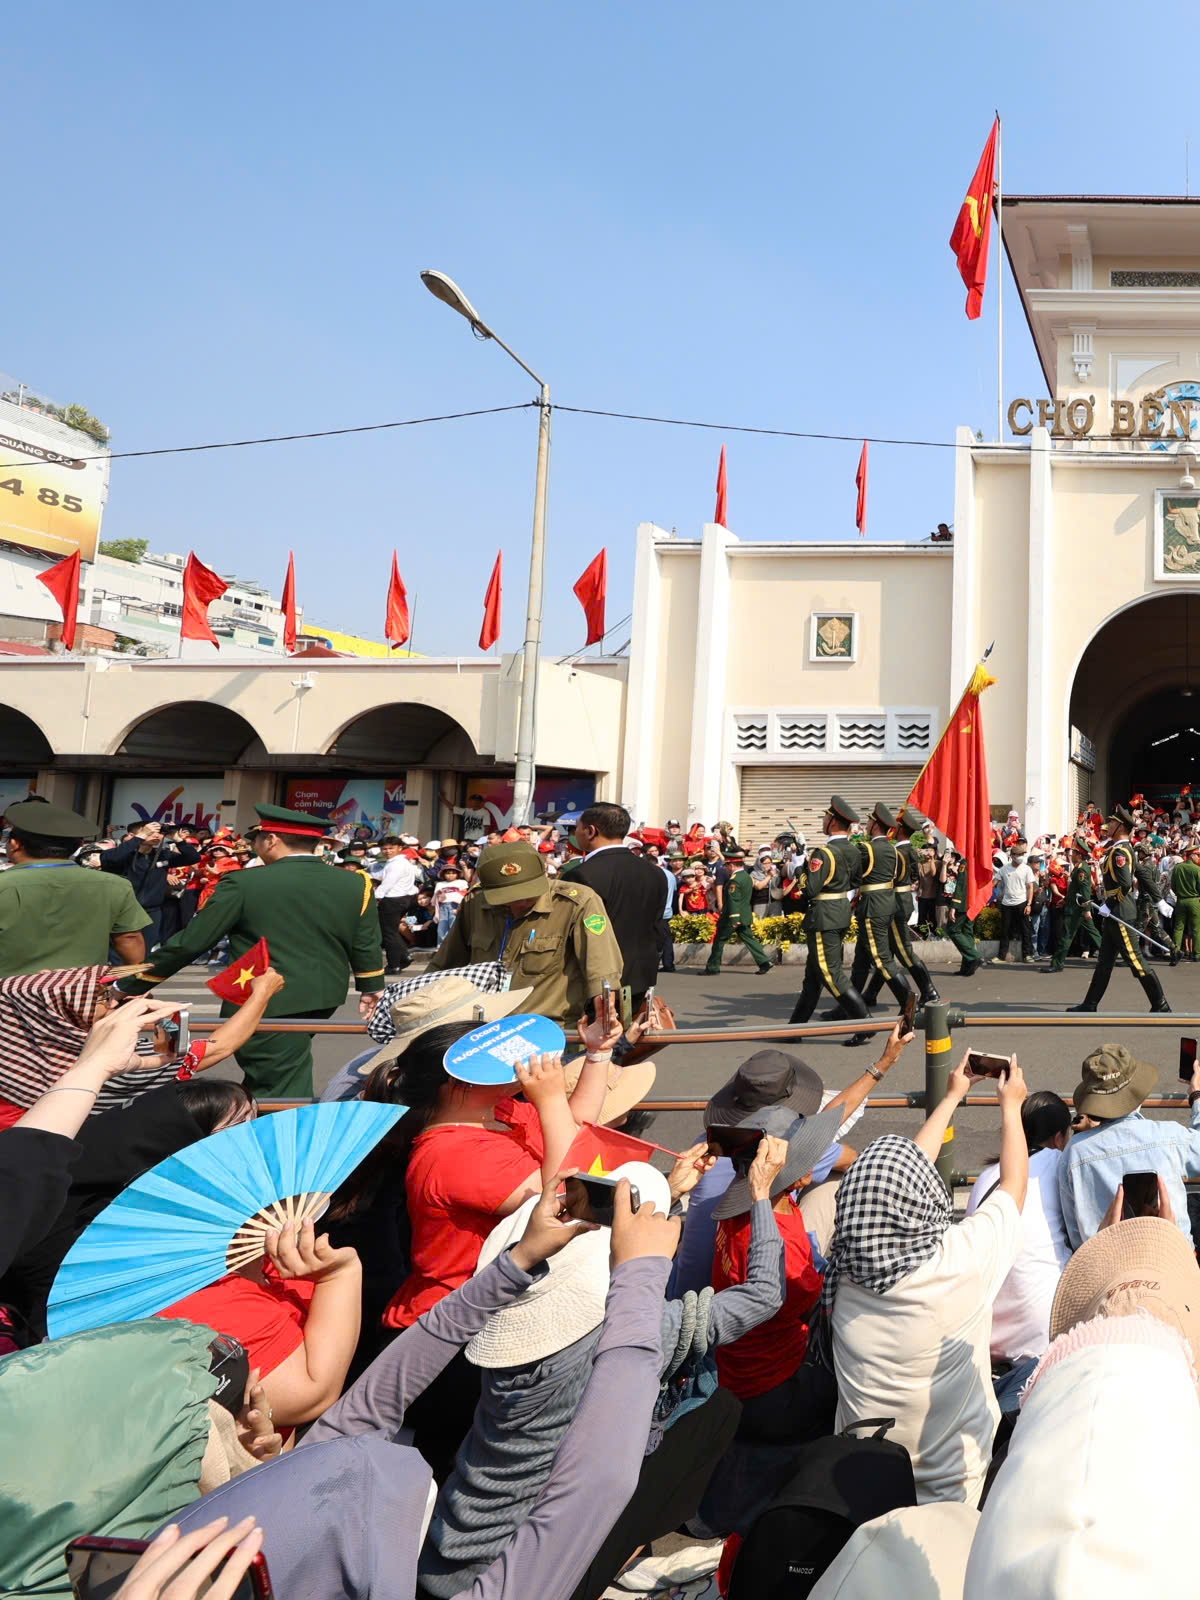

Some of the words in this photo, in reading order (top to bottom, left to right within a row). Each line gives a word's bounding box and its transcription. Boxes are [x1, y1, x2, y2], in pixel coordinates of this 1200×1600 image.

[1007, 396, 1096, 441] CHỢ
[1111, 388, 1191, 439] BẾN
[37, 487, 83, 513] 85
[294, 800, 312, 808] cảm
[313, 799, 336, 809] hứng,
[295, 790, 319, 800] Chạm
